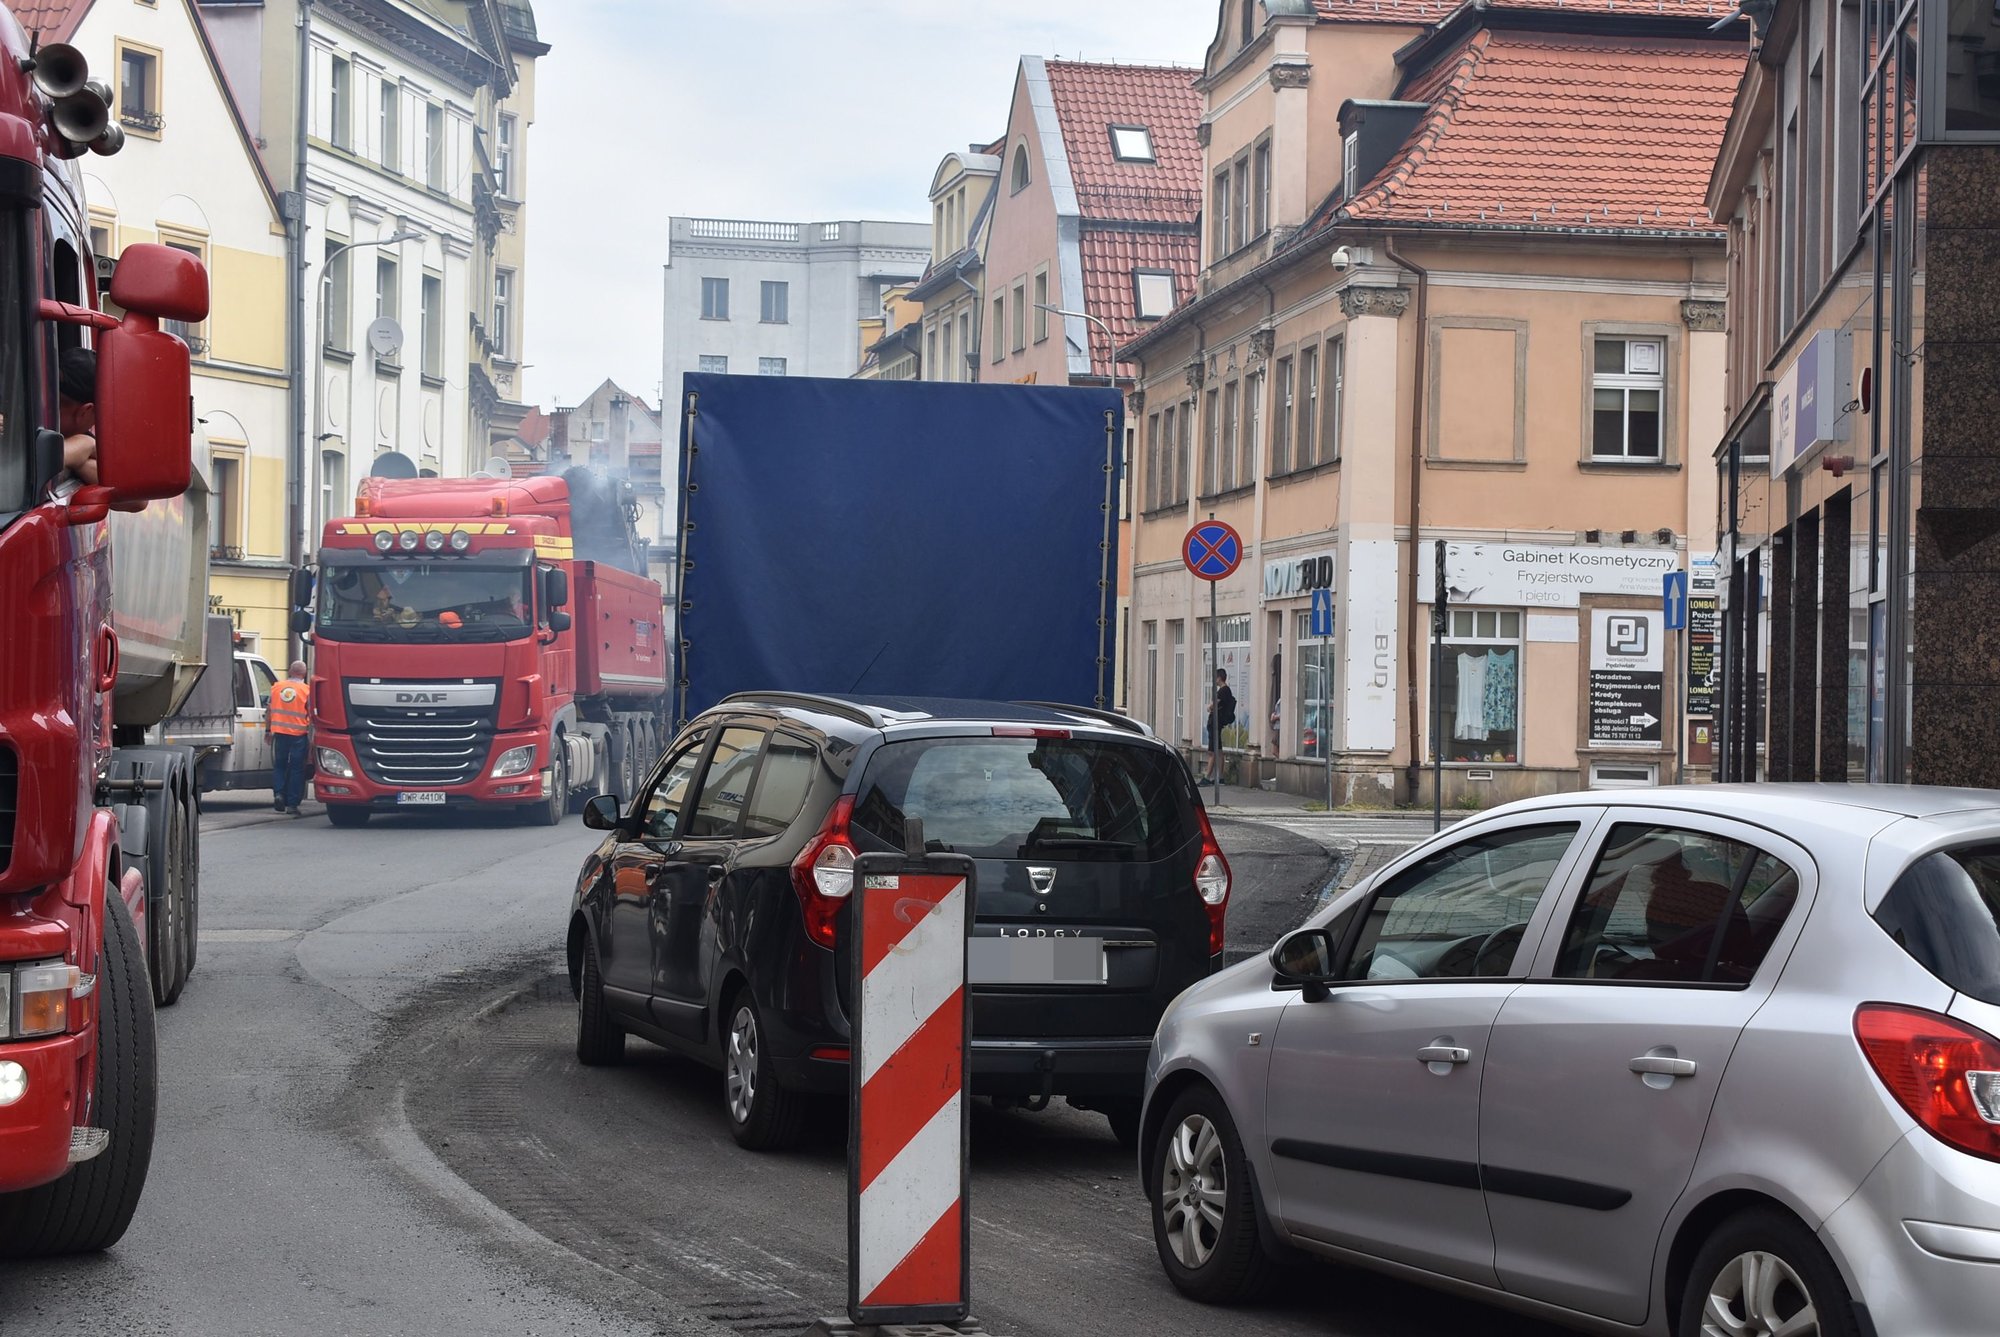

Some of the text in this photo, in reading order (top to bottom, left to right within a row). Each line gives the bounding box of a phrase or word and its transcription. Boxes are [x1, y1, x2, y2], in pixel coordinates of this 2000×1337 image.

[1502, 549, 1675, 570] Gabinet Kosmetyczny
[1517, 570, 1594, 585] Fryzjerstwo
[1517, 590, 1561, 602] 1 piętro
[396, 693, 447, 703] DAF
[1594, 691, 1622, 699] Kredyty
[1594, 700, 1642, 708] Kompleksowa
[1000, 928, 1082, 938] LODGY
